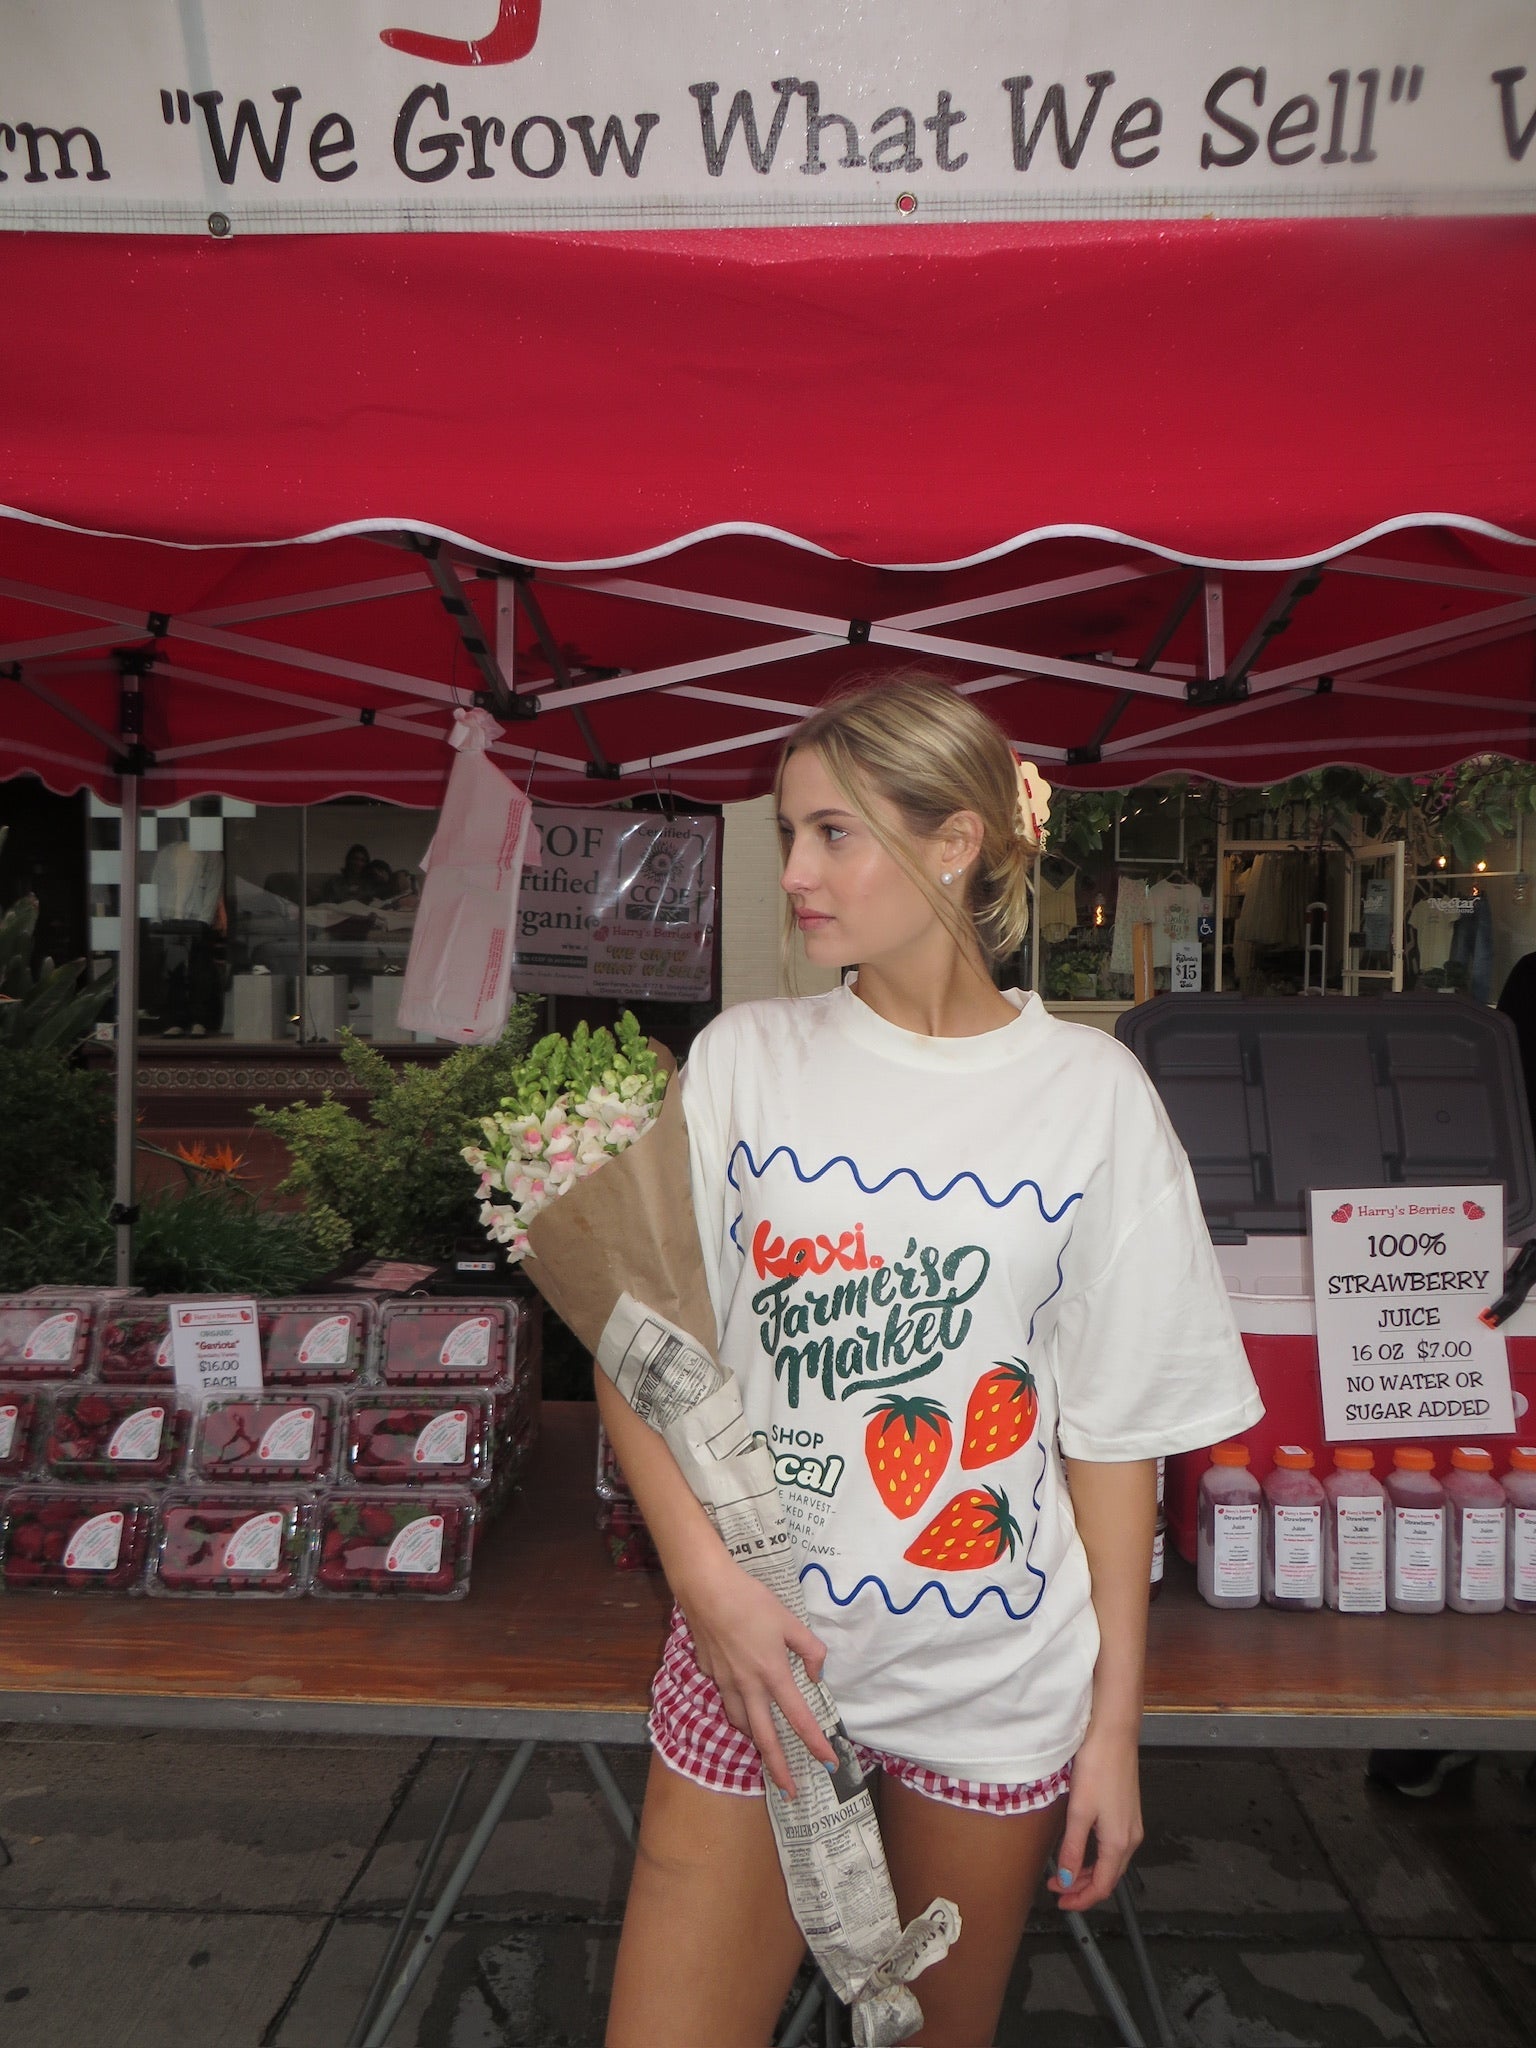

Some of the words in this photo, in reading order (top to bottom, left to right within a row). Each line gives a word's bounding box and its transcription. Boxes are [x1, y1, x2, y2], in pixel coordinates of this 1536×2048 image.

[160, 86, 358, 185] "We
[393, 82, 660, 184] Grow
[688, 76, 969, 178] What
[1002, 69, 1164, 172] We
[1199, 65, 1425, 170] Sell"
[1428, 897, 1480, 911] Nectar
[1175, 964, 1197, 980] $15
[1357, 1204, 1405, 1218] Harry's
[1408, 1203, 1456, 1216] Berries
[1367, 1232, 1447, 1258] 100%
[1327, 1270, 1490, 1295] STRAWBERRY
[1377, 1307, 1441, 1328] JUICE
[1351, 1344, 1373, 1361] 16
[1377, 1343, 1404, 1360] OZ
[1416, 1338, 1473, 1362] $7.00
[199, 1359, 240, 1373] $16.00
[203, 1376, 238, 1388] EACH
[1346, 1375, 1375, 1393] NO
[1379, 1373, 1450, 1392] WATER
[1455, 1371, 1484, 1388] OR
[1345, 1402, 1412, 1421] SUGAR
[1417, 1399, 1490, 1419] ADDED
[771, 1424, 824, 1449] SHOP
[766, 1446, 845, 1498] cal
[808, 1512, 826, 1527] FOR
[820, 1801, 860, 1829] THOMAS
